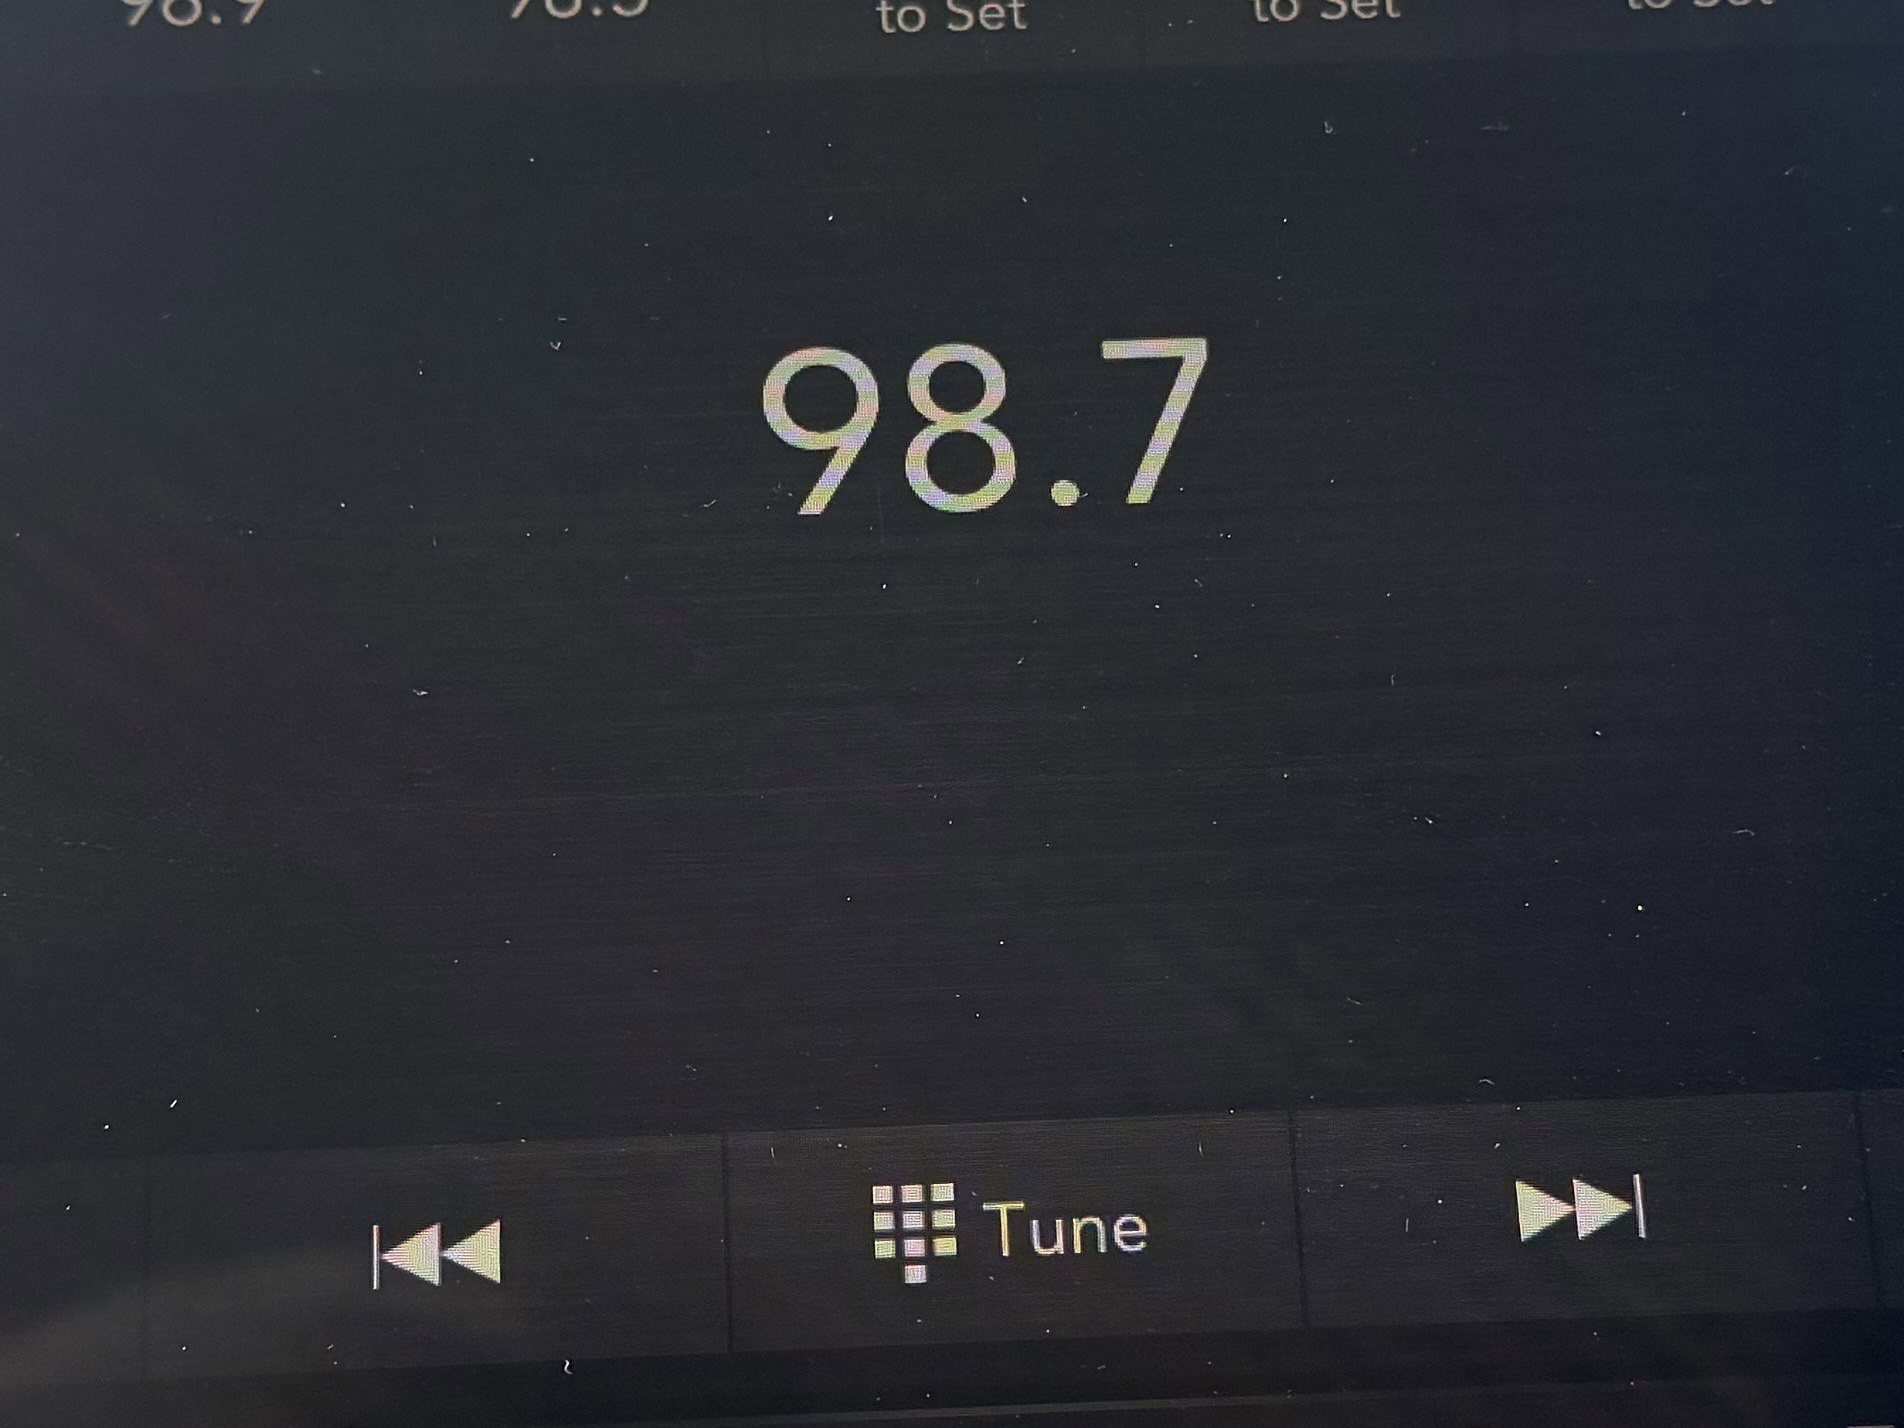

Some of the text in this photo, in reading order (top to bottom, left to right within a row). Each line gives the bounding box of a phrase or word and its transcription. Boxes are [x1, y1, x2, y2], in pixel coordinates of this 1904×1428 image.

[875, 0, 926, 34] to
[762, 337, 1208, 516] 98.7
[982, 1201, 1148, 1257] Tune
